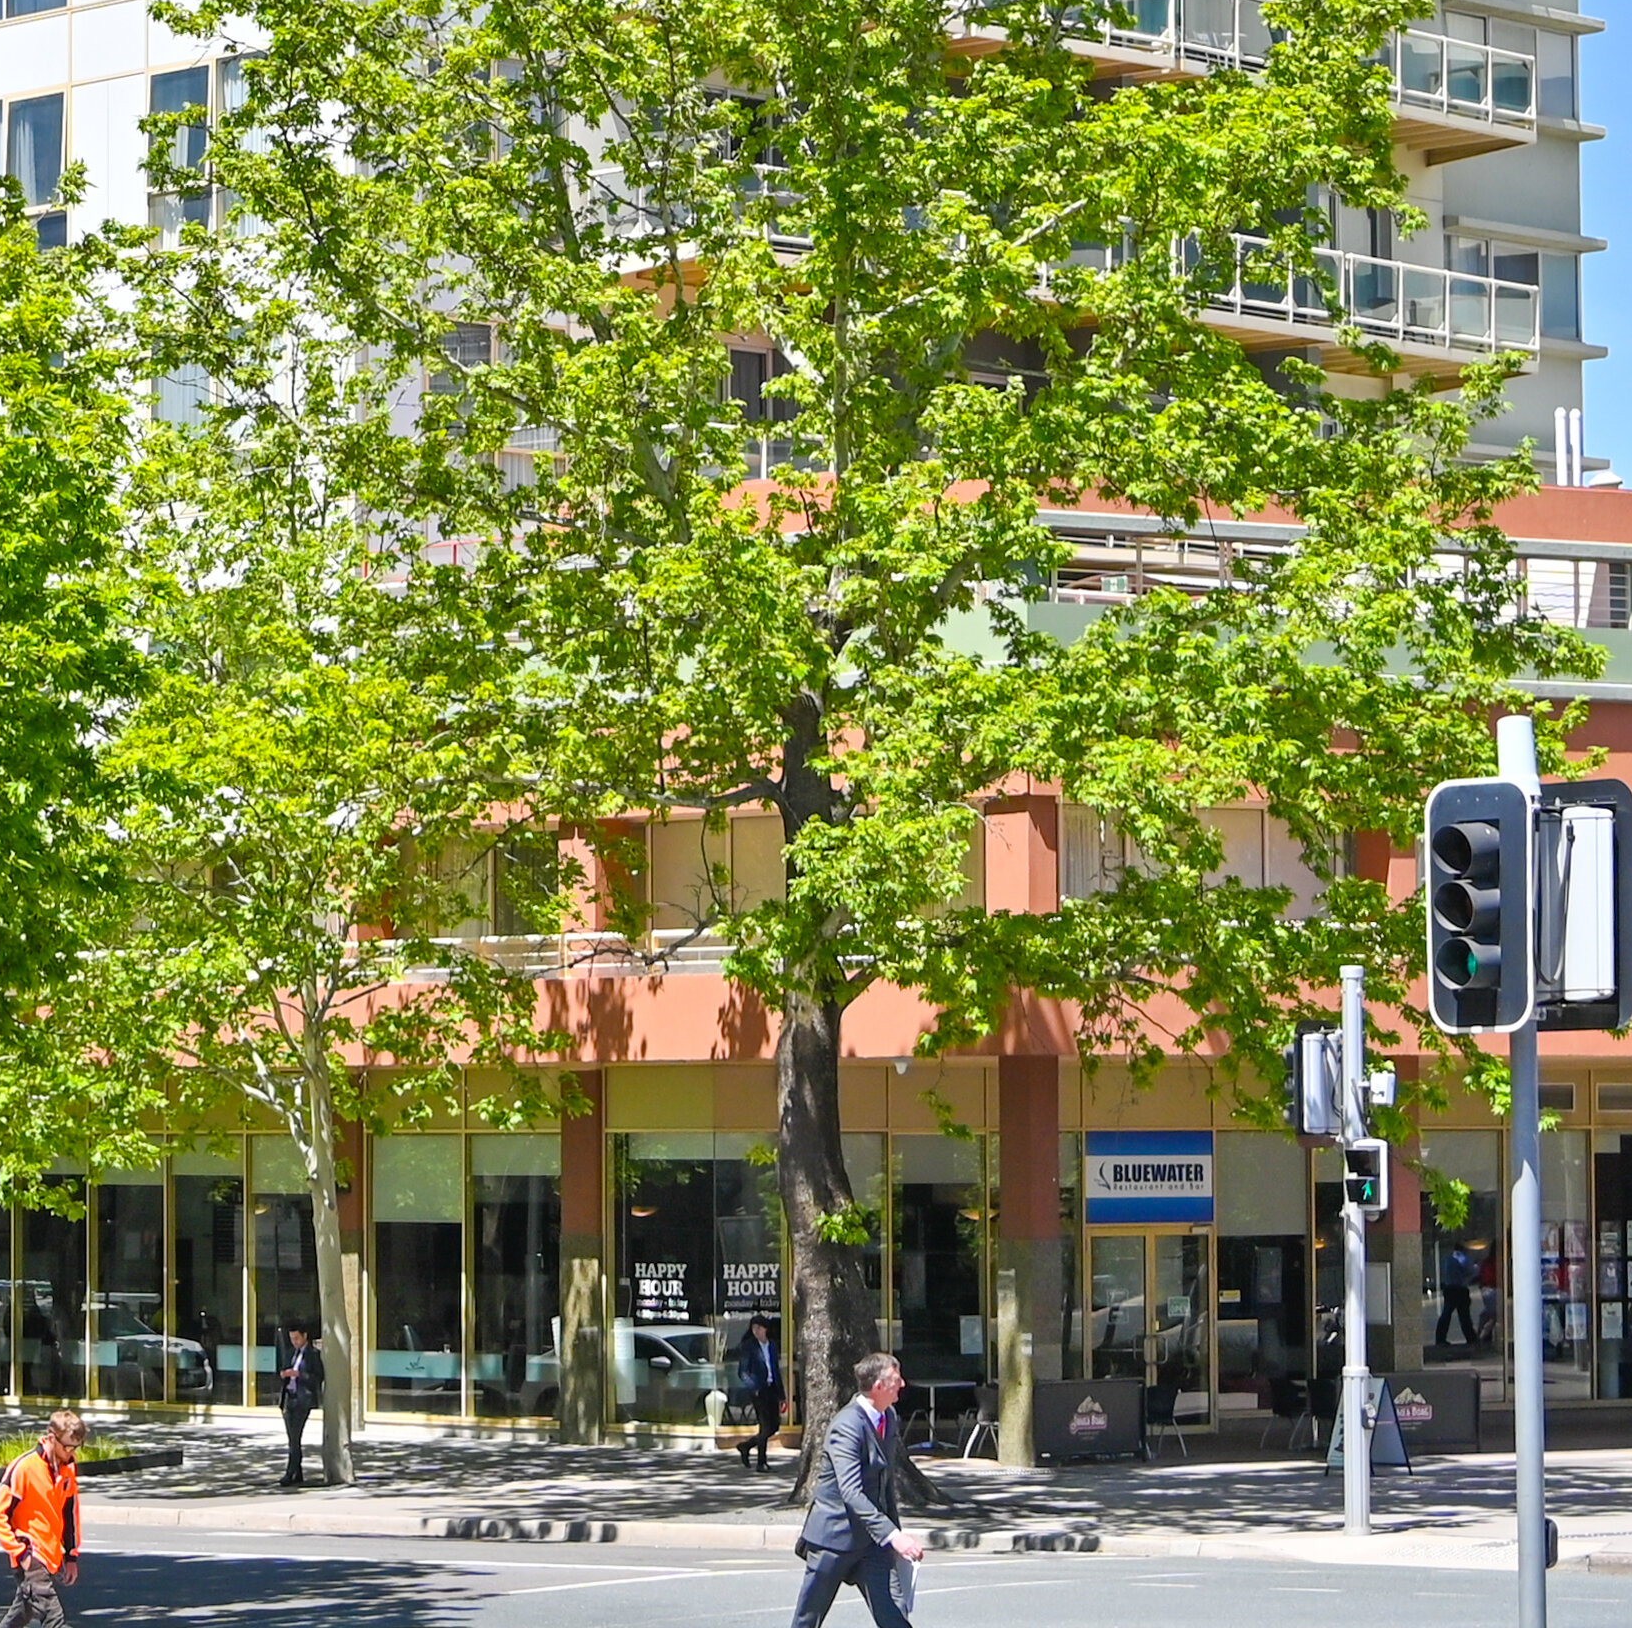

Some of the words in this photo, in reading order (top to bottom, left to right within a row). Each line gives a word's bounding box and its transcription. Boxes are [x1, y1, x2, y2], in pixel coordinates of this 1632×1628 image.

[1113, 1164, 1204, 1183] BLUEWATER
[1113, 1183, 1164, 1191] Restaurant
[635, 1262, 687, 1279] HAPPY
[723, 1263, 780, 1279] HAPPY
[639, 1279, 684, 1296] HOUR
[727, 1280, 777, 1297] HOUR
